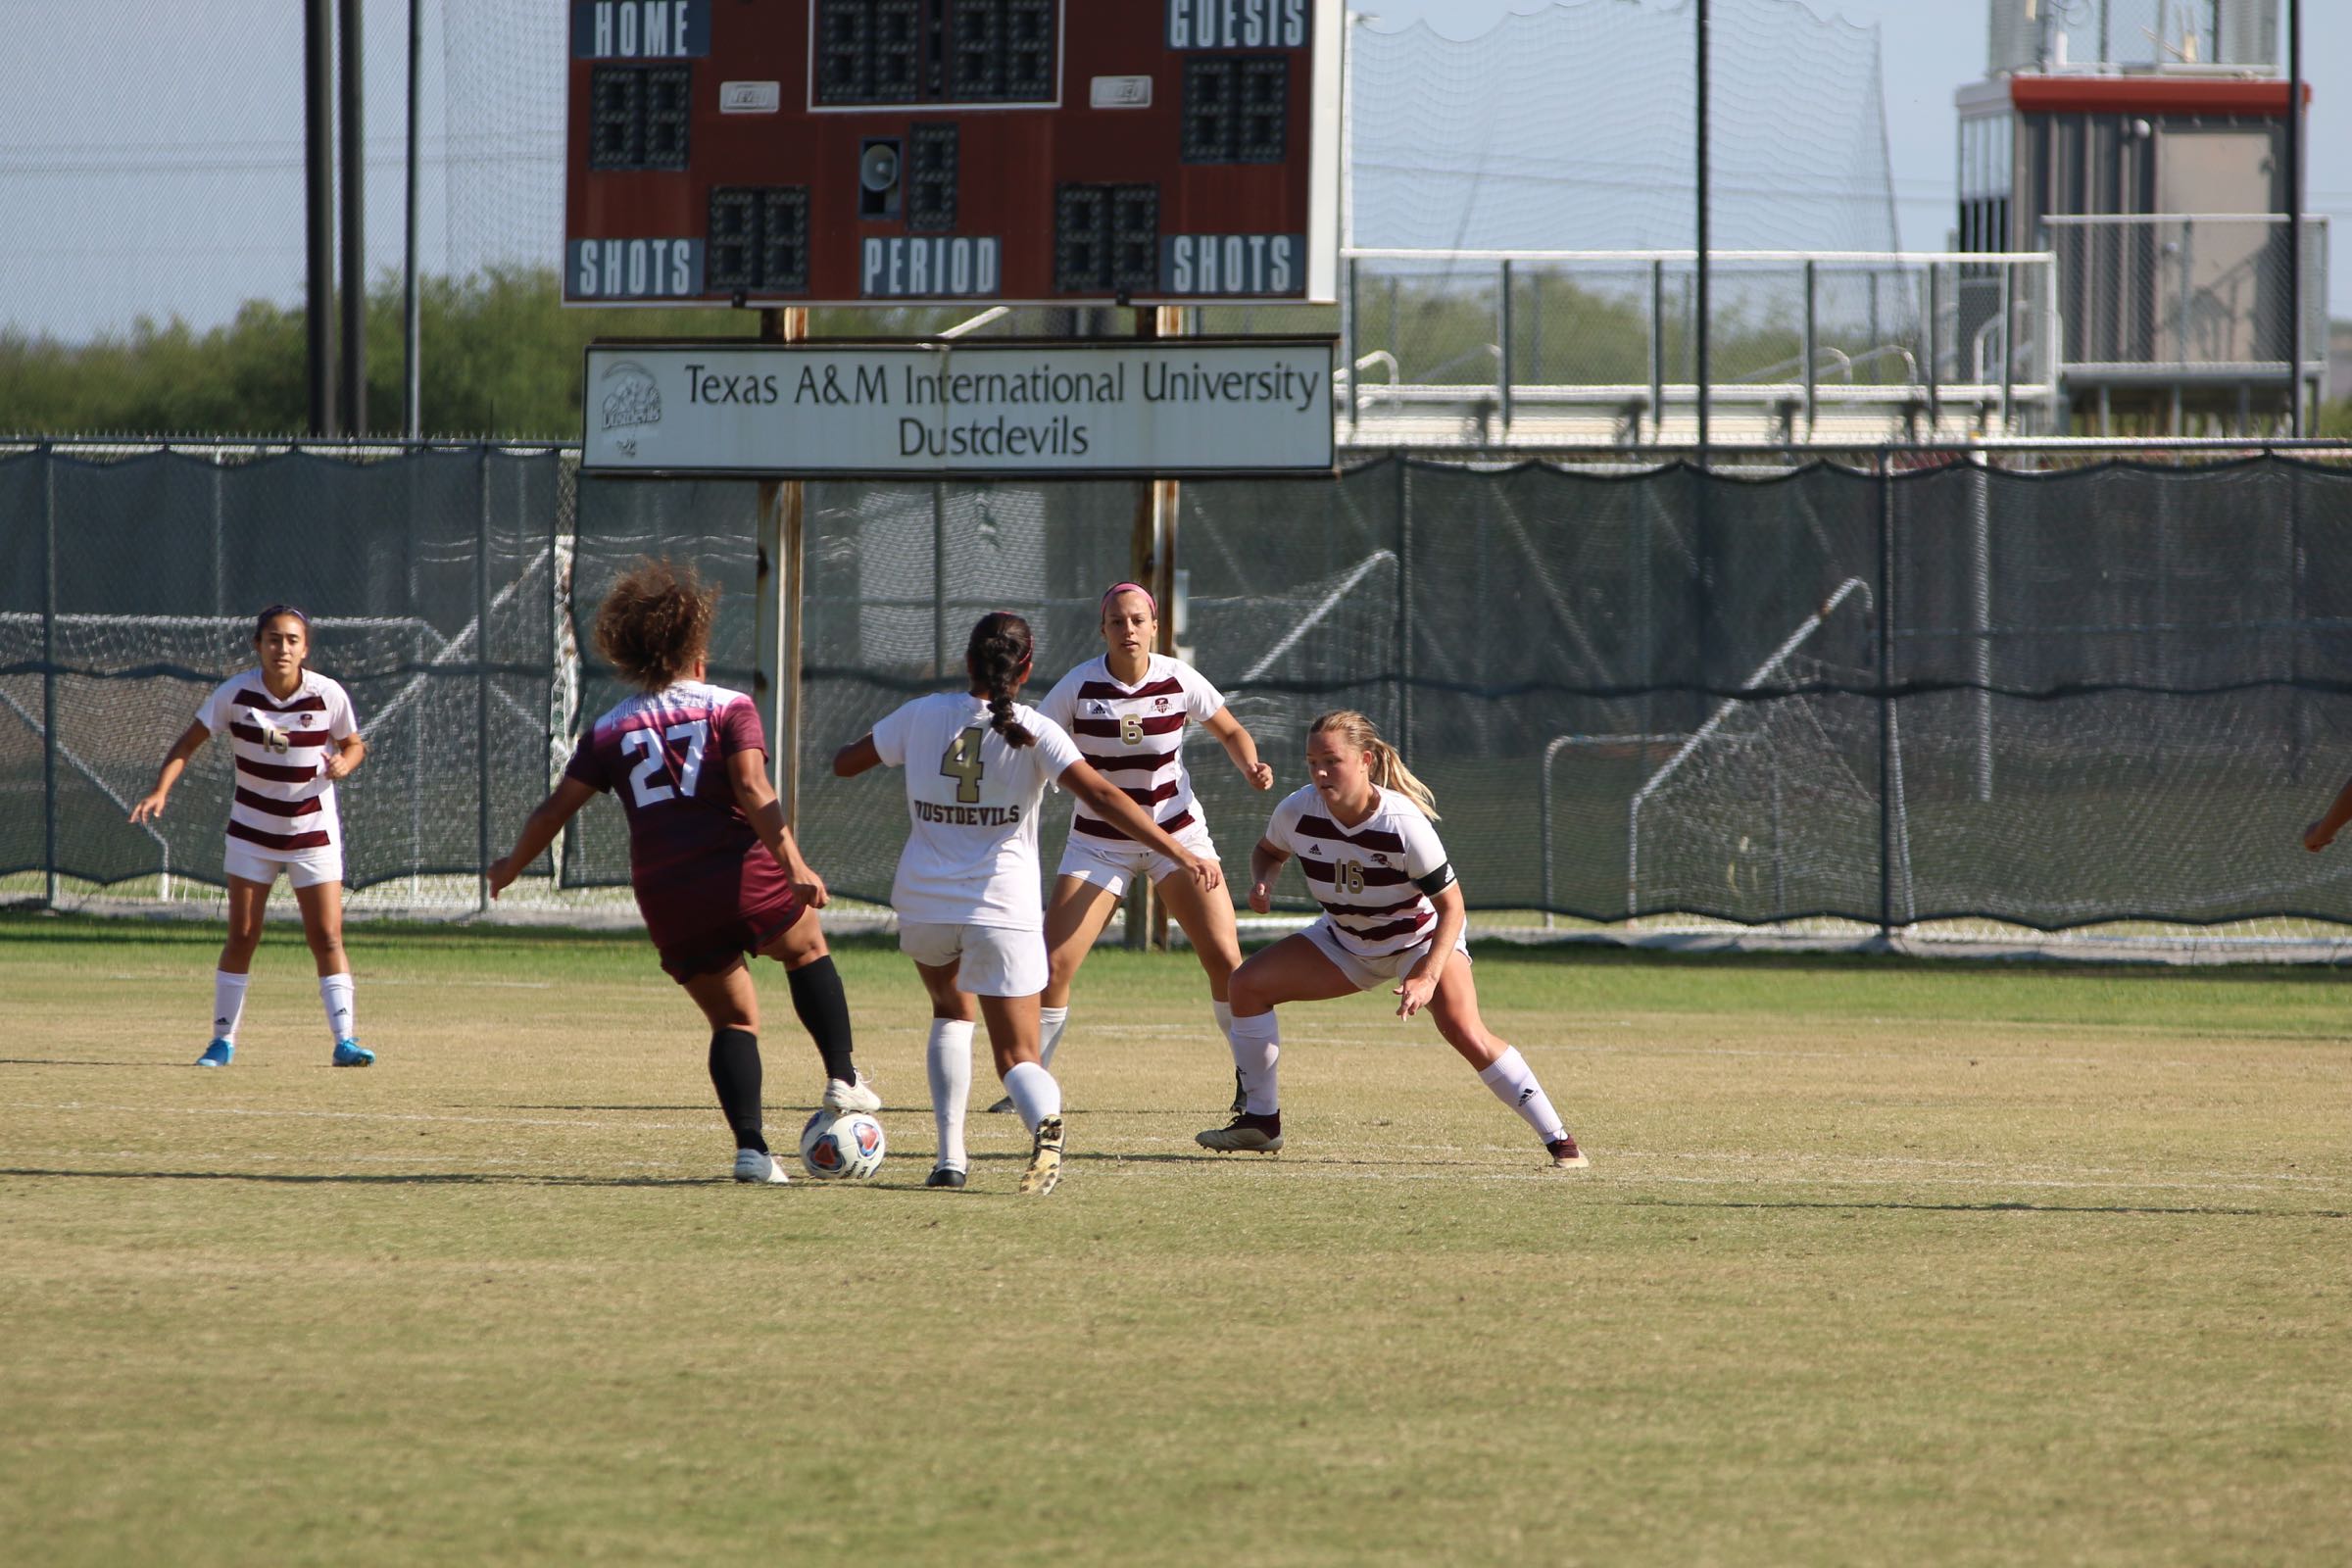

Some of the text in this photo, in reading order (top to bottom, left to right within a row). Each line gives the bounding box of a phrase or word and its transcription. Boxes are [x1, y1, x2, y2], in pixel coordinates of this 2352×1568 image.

[595, 0, 688, 57] HOME
[1170, 0, 1303, 47] GUESTS
[579, 239, 690, 295] SHOTS
[864, 236, 996, 294] PERIOD
[1173, 235, 1291, 292] SHOTS
[685, 362, 1318, 412] Texas A&M International University
[900, 416, 1089, 457] Dustdevils
[263, 727, 289, 755] 15
[1120, 713, 1144, 745] 6
[620, 719, 708, 808] 27
[940, 726, 984, 804] 4
[1334, 858, 1364, 894] 16
